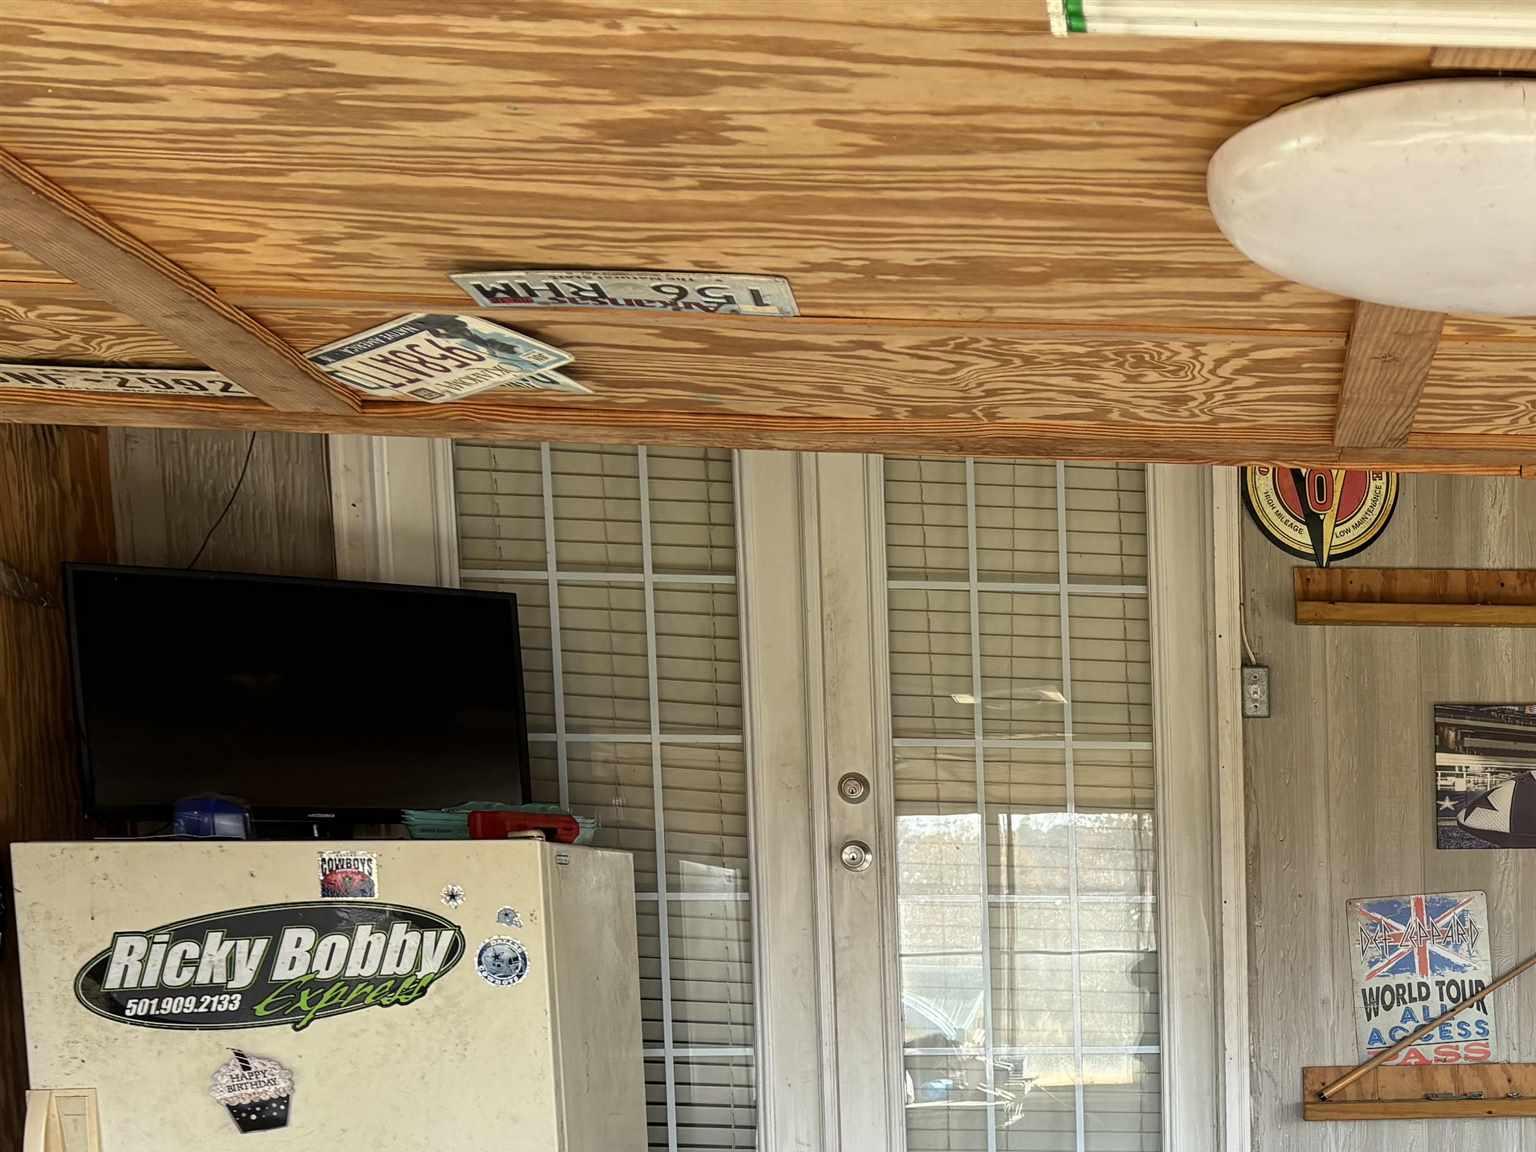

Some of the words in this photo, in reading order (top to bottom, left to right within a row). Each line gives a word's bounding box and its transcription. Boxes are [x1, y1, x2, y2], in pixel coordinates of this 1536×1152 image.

[470, 281, 600, 302] RHM
[652, 283, 770, 308] 156
[0, 370, 245, 393] NF-2992
[1275, 508, 1304, 535] MILEAGE
[1335, 527, 1352, 539] LOW
[1352, 484, 1383, 531] MAINTENANCE
[320, 857, 374, 877] COWBOYS
[1358, 918, 1391, 961] DEF
[1400, 912, 1480, 955] LEPPARD
[103, 930, 272, 991] Ricky
[269, 921, 456, 983] Bobby
[124, 993, 243, 1017] 501.909.2133
[253, 972, 434, 1027] Express
[1361, 980, 1431, 1022] WORLD
[1435, 978, 1488, 1016] TOUR
[1367, 1019, 1490, 1046] ACCESS
[226, 1077, 278, 1093] BIRTHDAY
[230, 1070, 268, 1083] HAPPY
